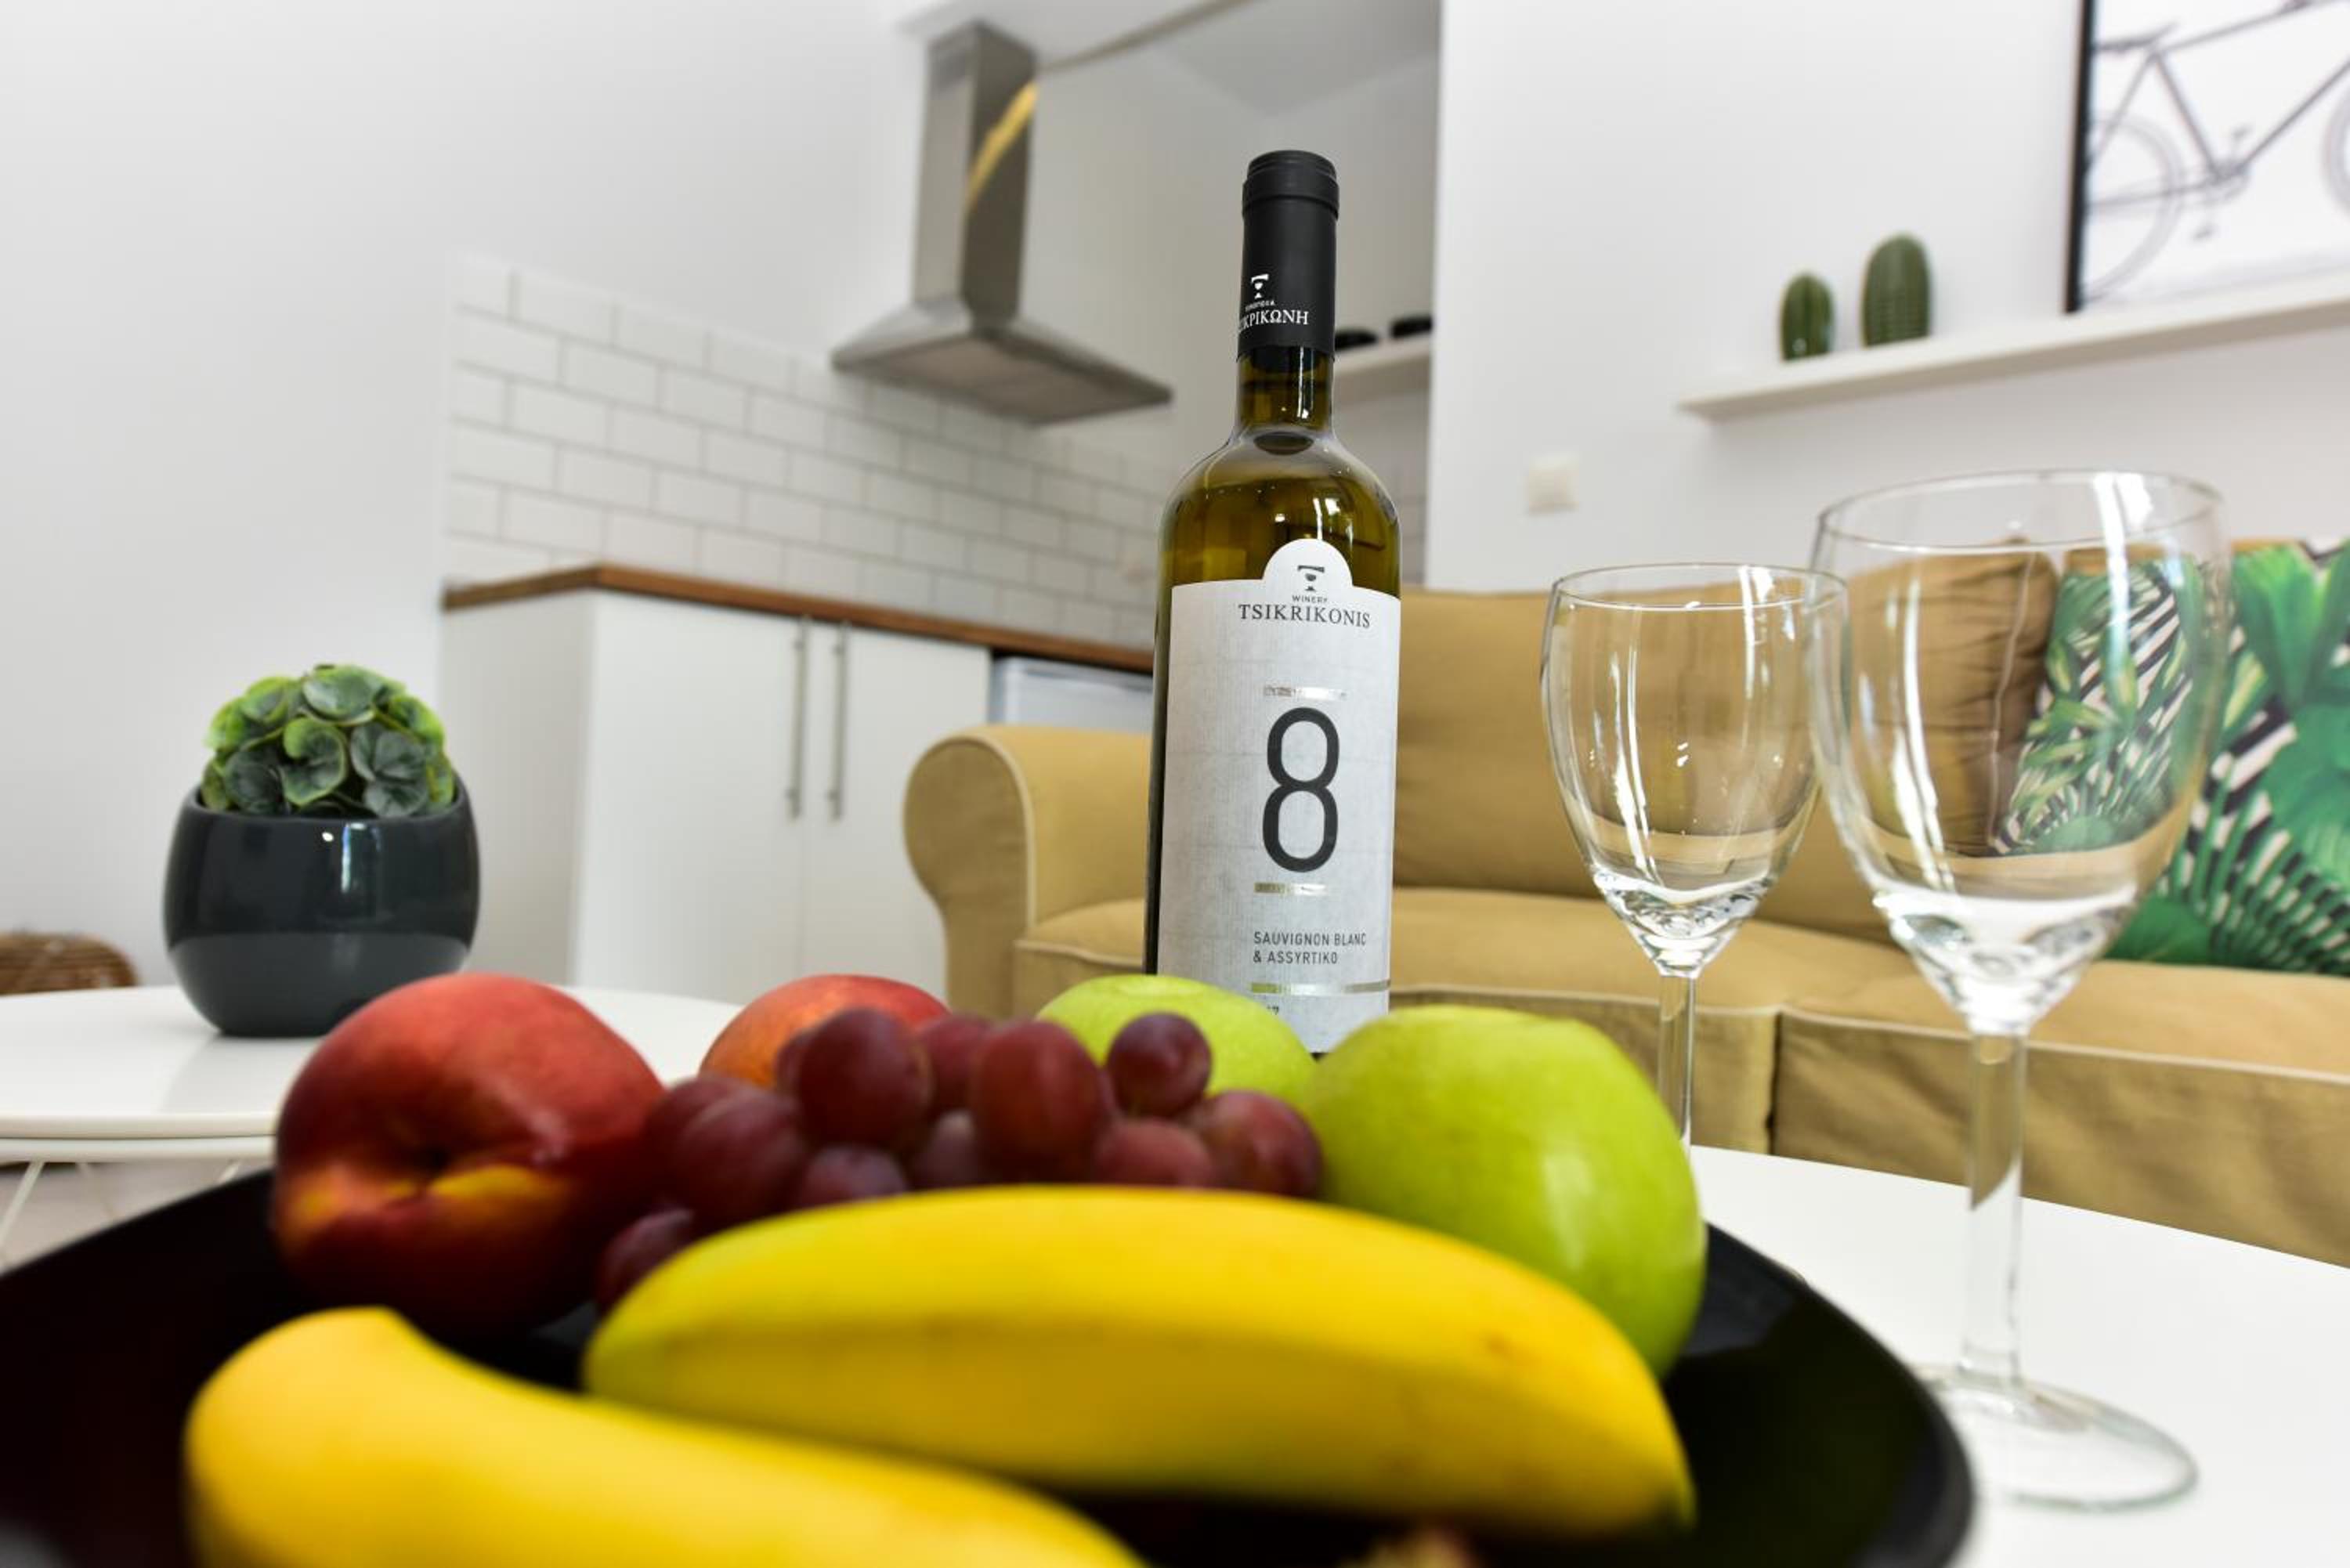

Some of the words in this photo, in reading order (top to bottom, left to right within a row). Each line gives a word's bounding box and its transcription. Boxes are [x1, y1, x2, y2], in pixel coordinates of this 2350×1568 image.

[1239, 309, 1310, 331] ΚΡΙΚΩΝΗ
[1292, 594, 1328, 604] WINERY
[1238, 603, 1371, 629] TSIKRIKONIS
[1263, 706, 1340, 873] 8
[1253, 931, 1329, 946] SAUVIGNON
[1334, 933, 1367, 947] BLANC
[1253, 950, 1262, 963] &
[1267, 951, 1338, 964] ASSYRTIKO
